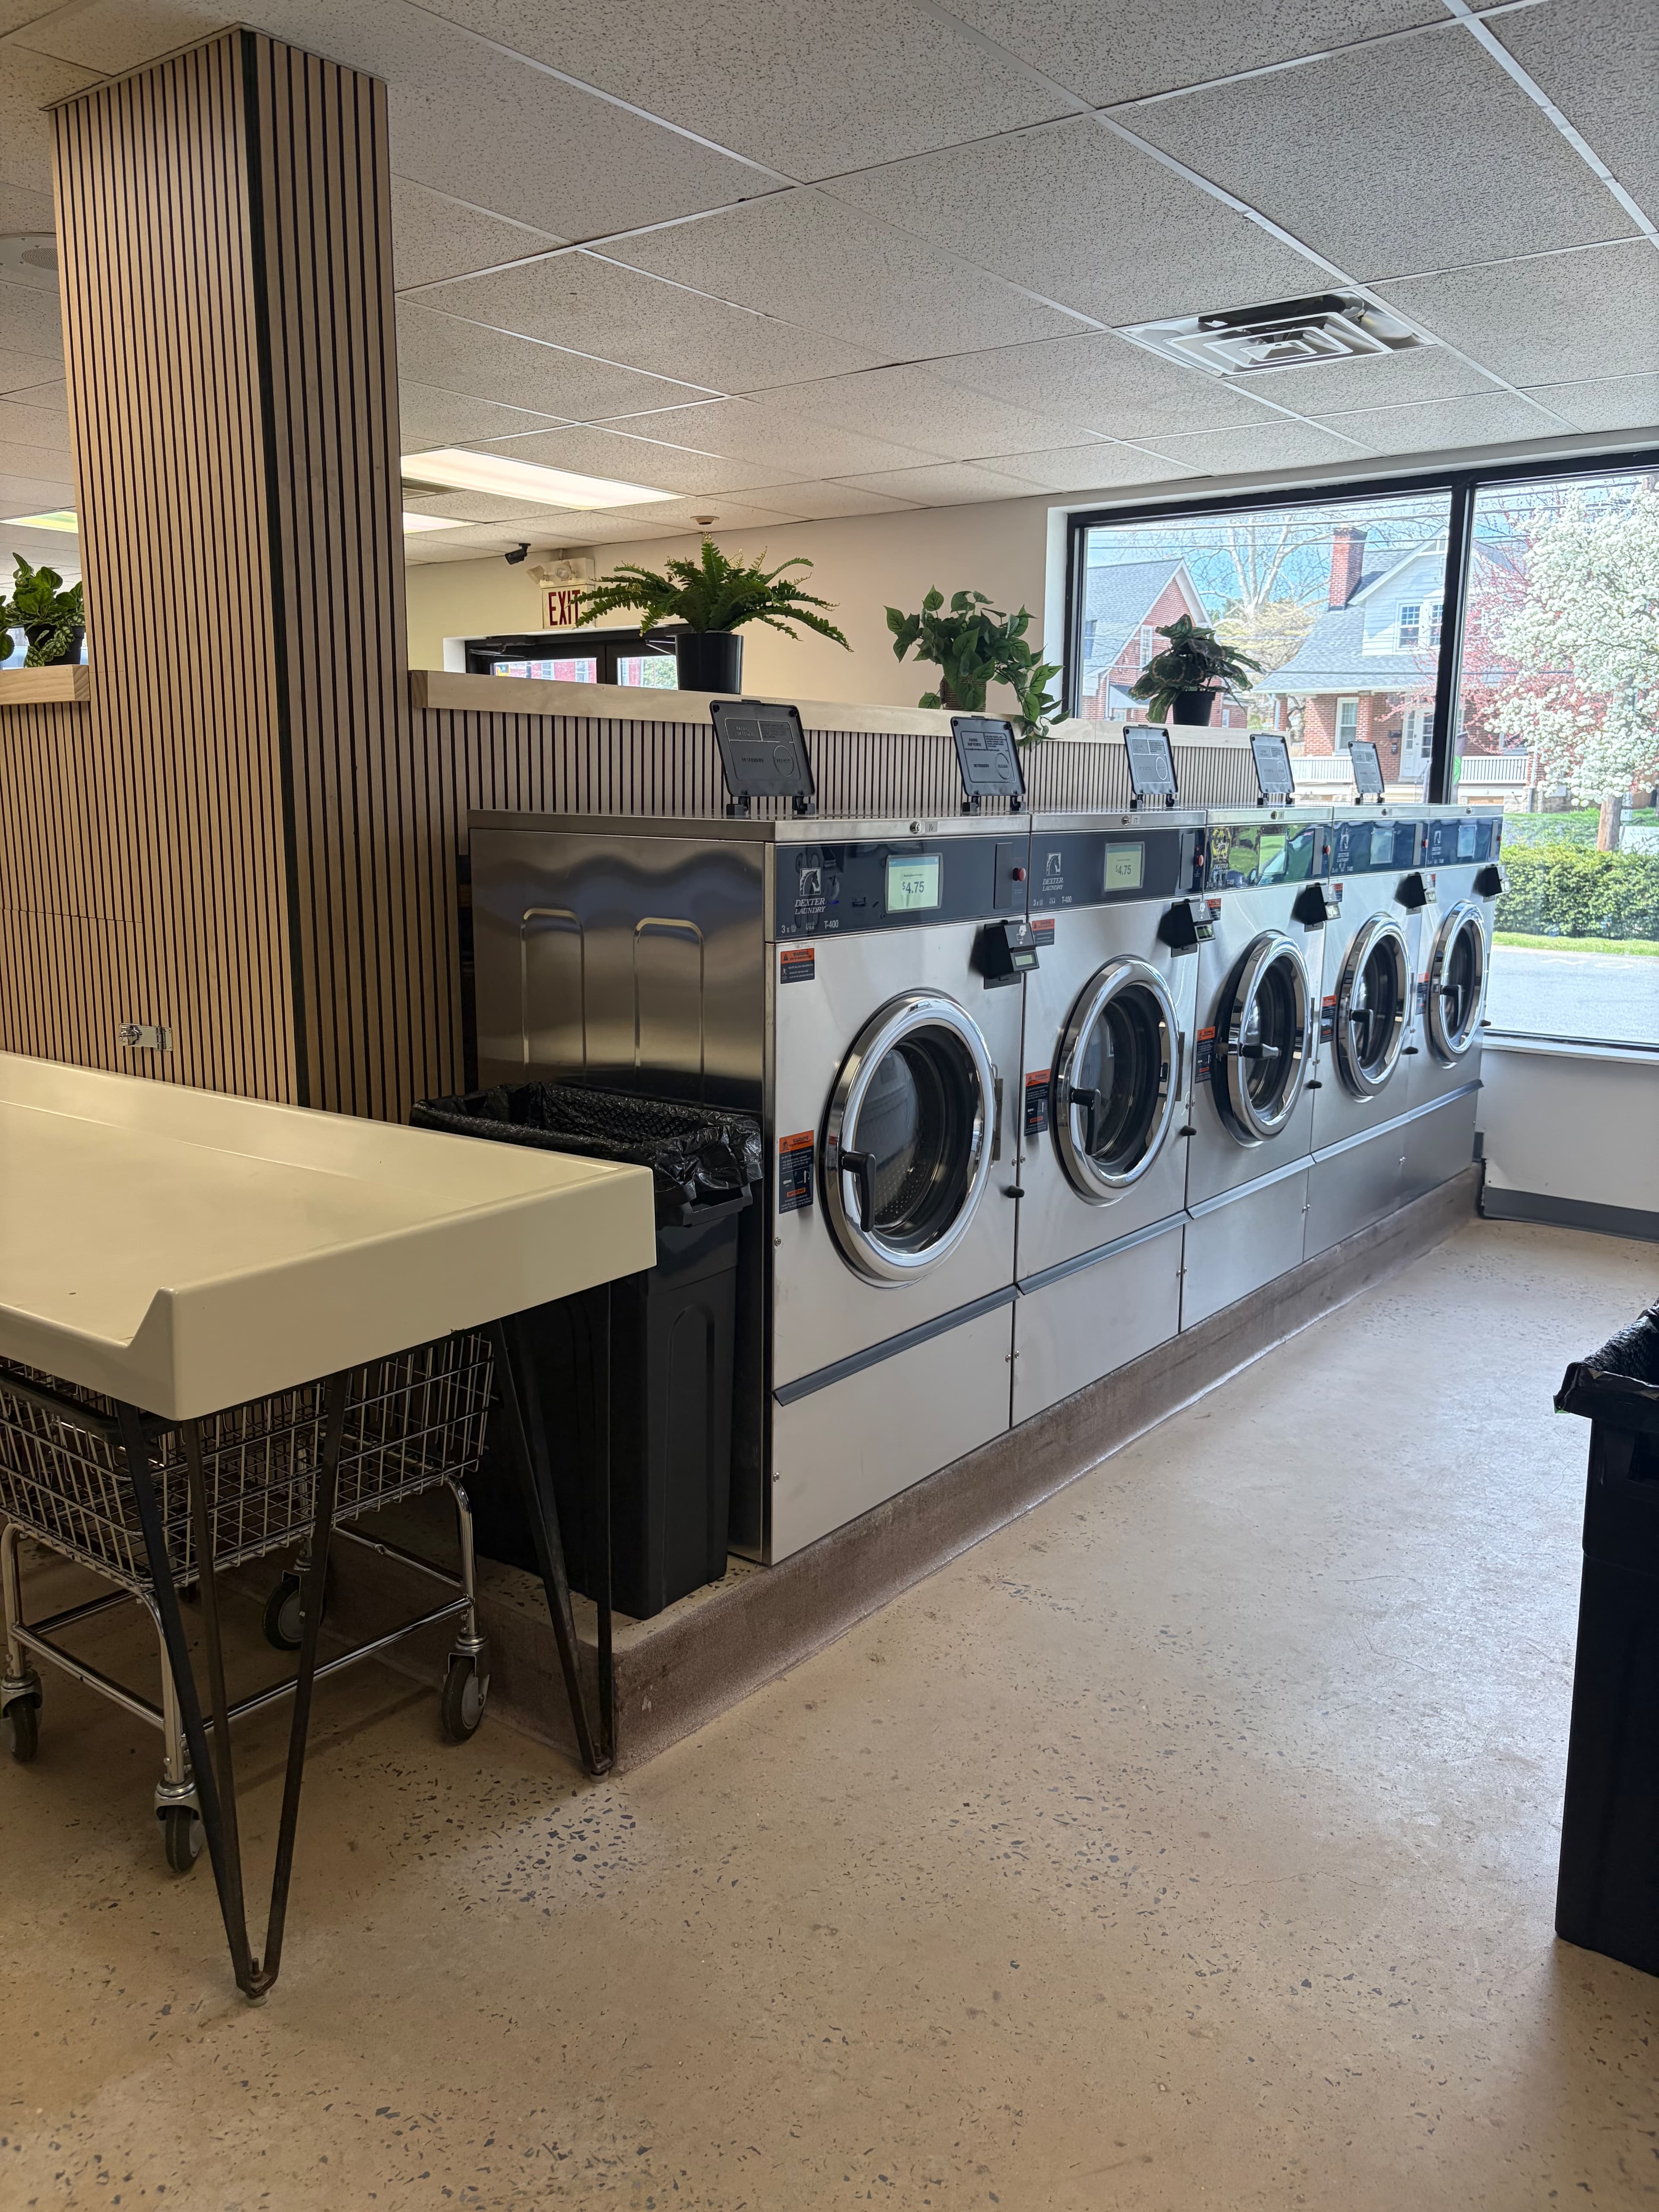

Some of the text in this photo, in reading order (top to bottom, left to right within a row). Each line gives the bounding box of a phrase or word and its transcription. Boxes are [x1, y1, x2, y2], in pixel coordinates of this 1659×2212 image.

[548, 589, 580, 626] EXIT
[1115, 865, 1131, 876] $4.75
[902, 881, 924, 894] $4.75
[795, 898, 825, 907] DEXTER
[795, 906, 826, 915] LAUNDRY
[824, 920, 839, 929] T-400
